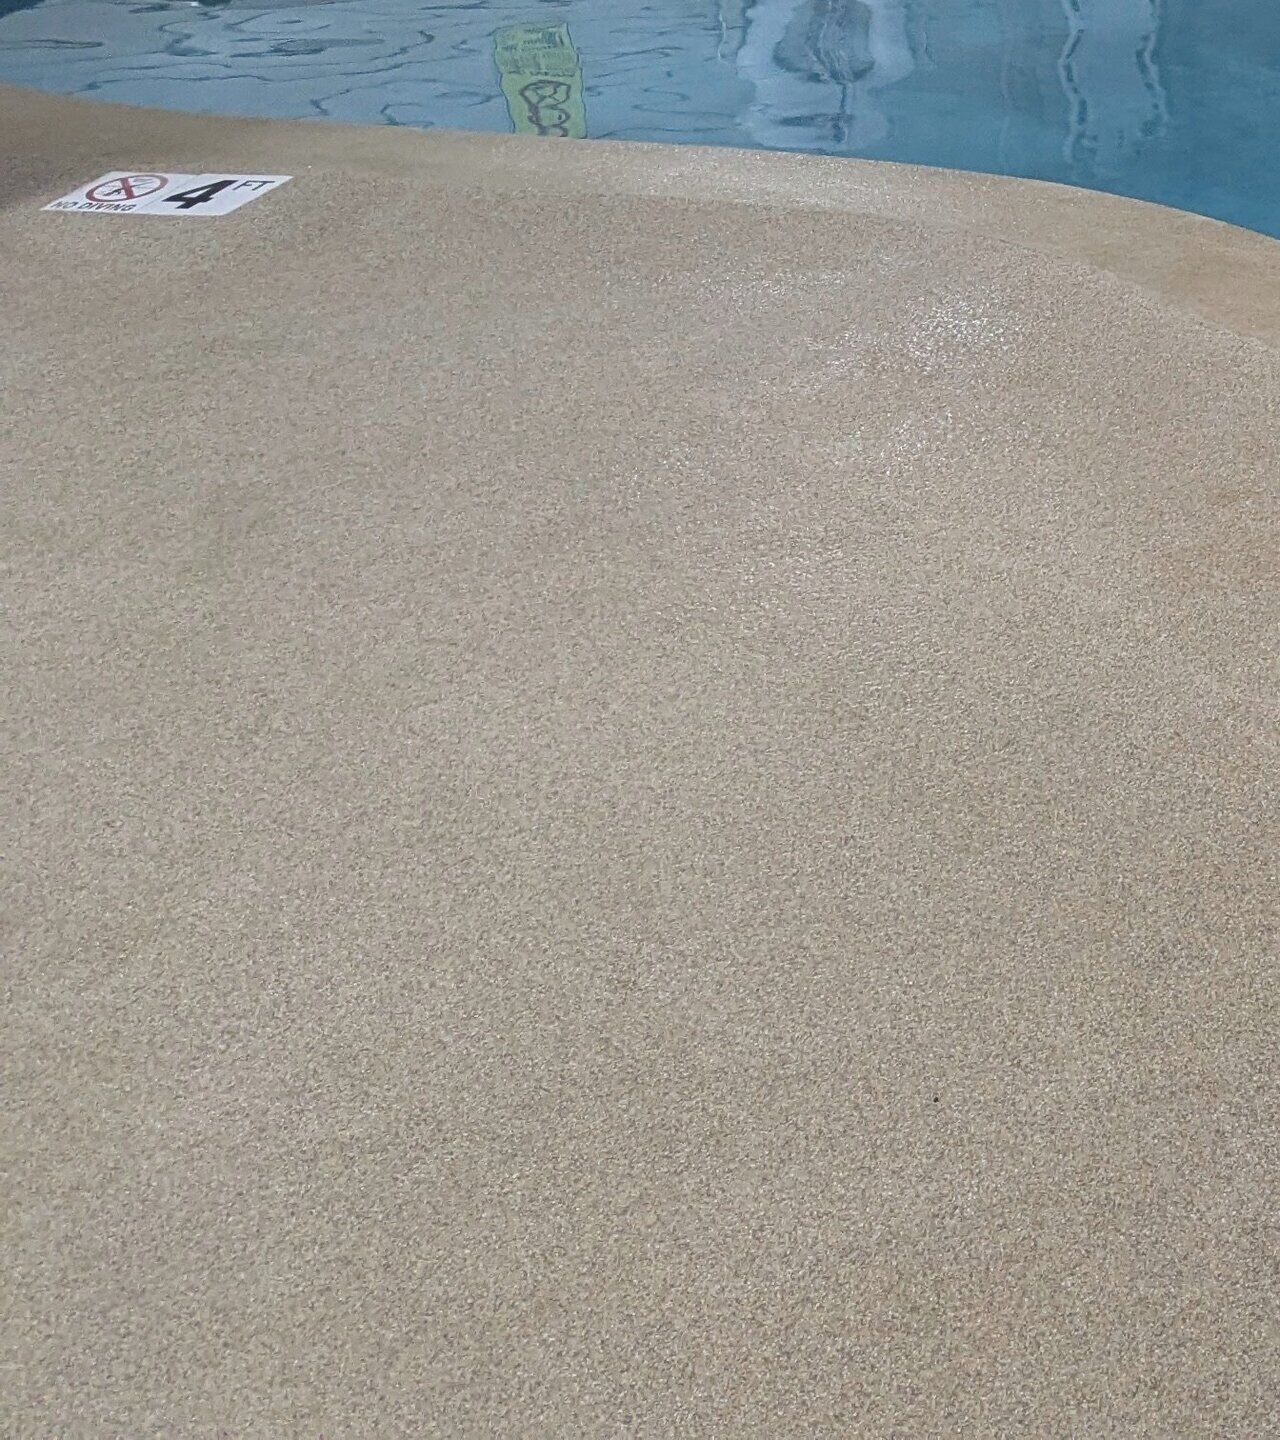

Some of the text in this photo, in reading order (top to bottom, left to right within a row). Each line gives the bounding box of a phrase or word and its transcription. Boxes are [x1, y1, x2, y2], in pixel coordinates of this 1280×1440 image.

[162, 179, 276, 210] 4 FT
[50, 201, 138, 212] NO DIVING
